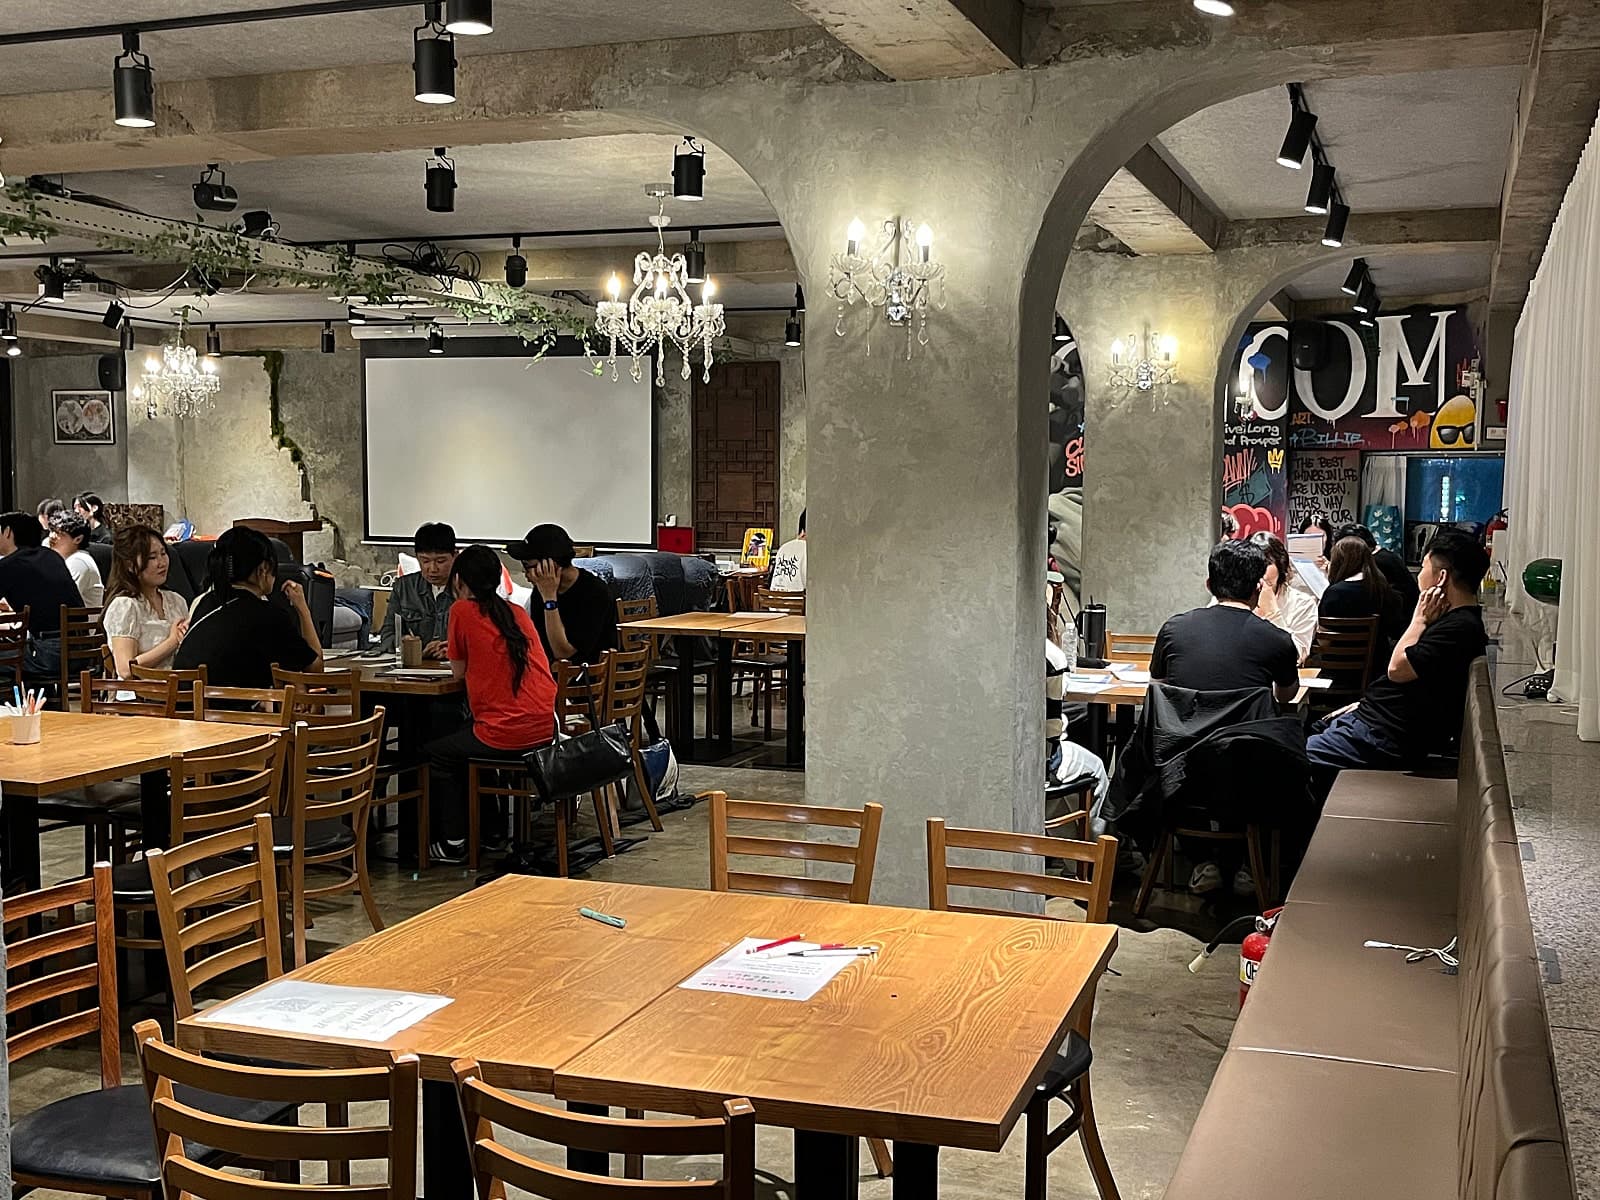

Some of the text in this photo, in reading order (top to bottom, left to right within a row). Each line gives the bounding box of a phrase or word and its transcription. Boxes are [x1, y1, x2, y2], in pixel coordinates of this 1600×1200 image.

[1224, 310, 1456, 422] OOM
[1224, 423, 1280, 437] ive Long
[1294, 456, 1345, 468] THE BEST
[1290, 483, 1308, 495] ARE
[1324, 496, 1343, 510] WHY
